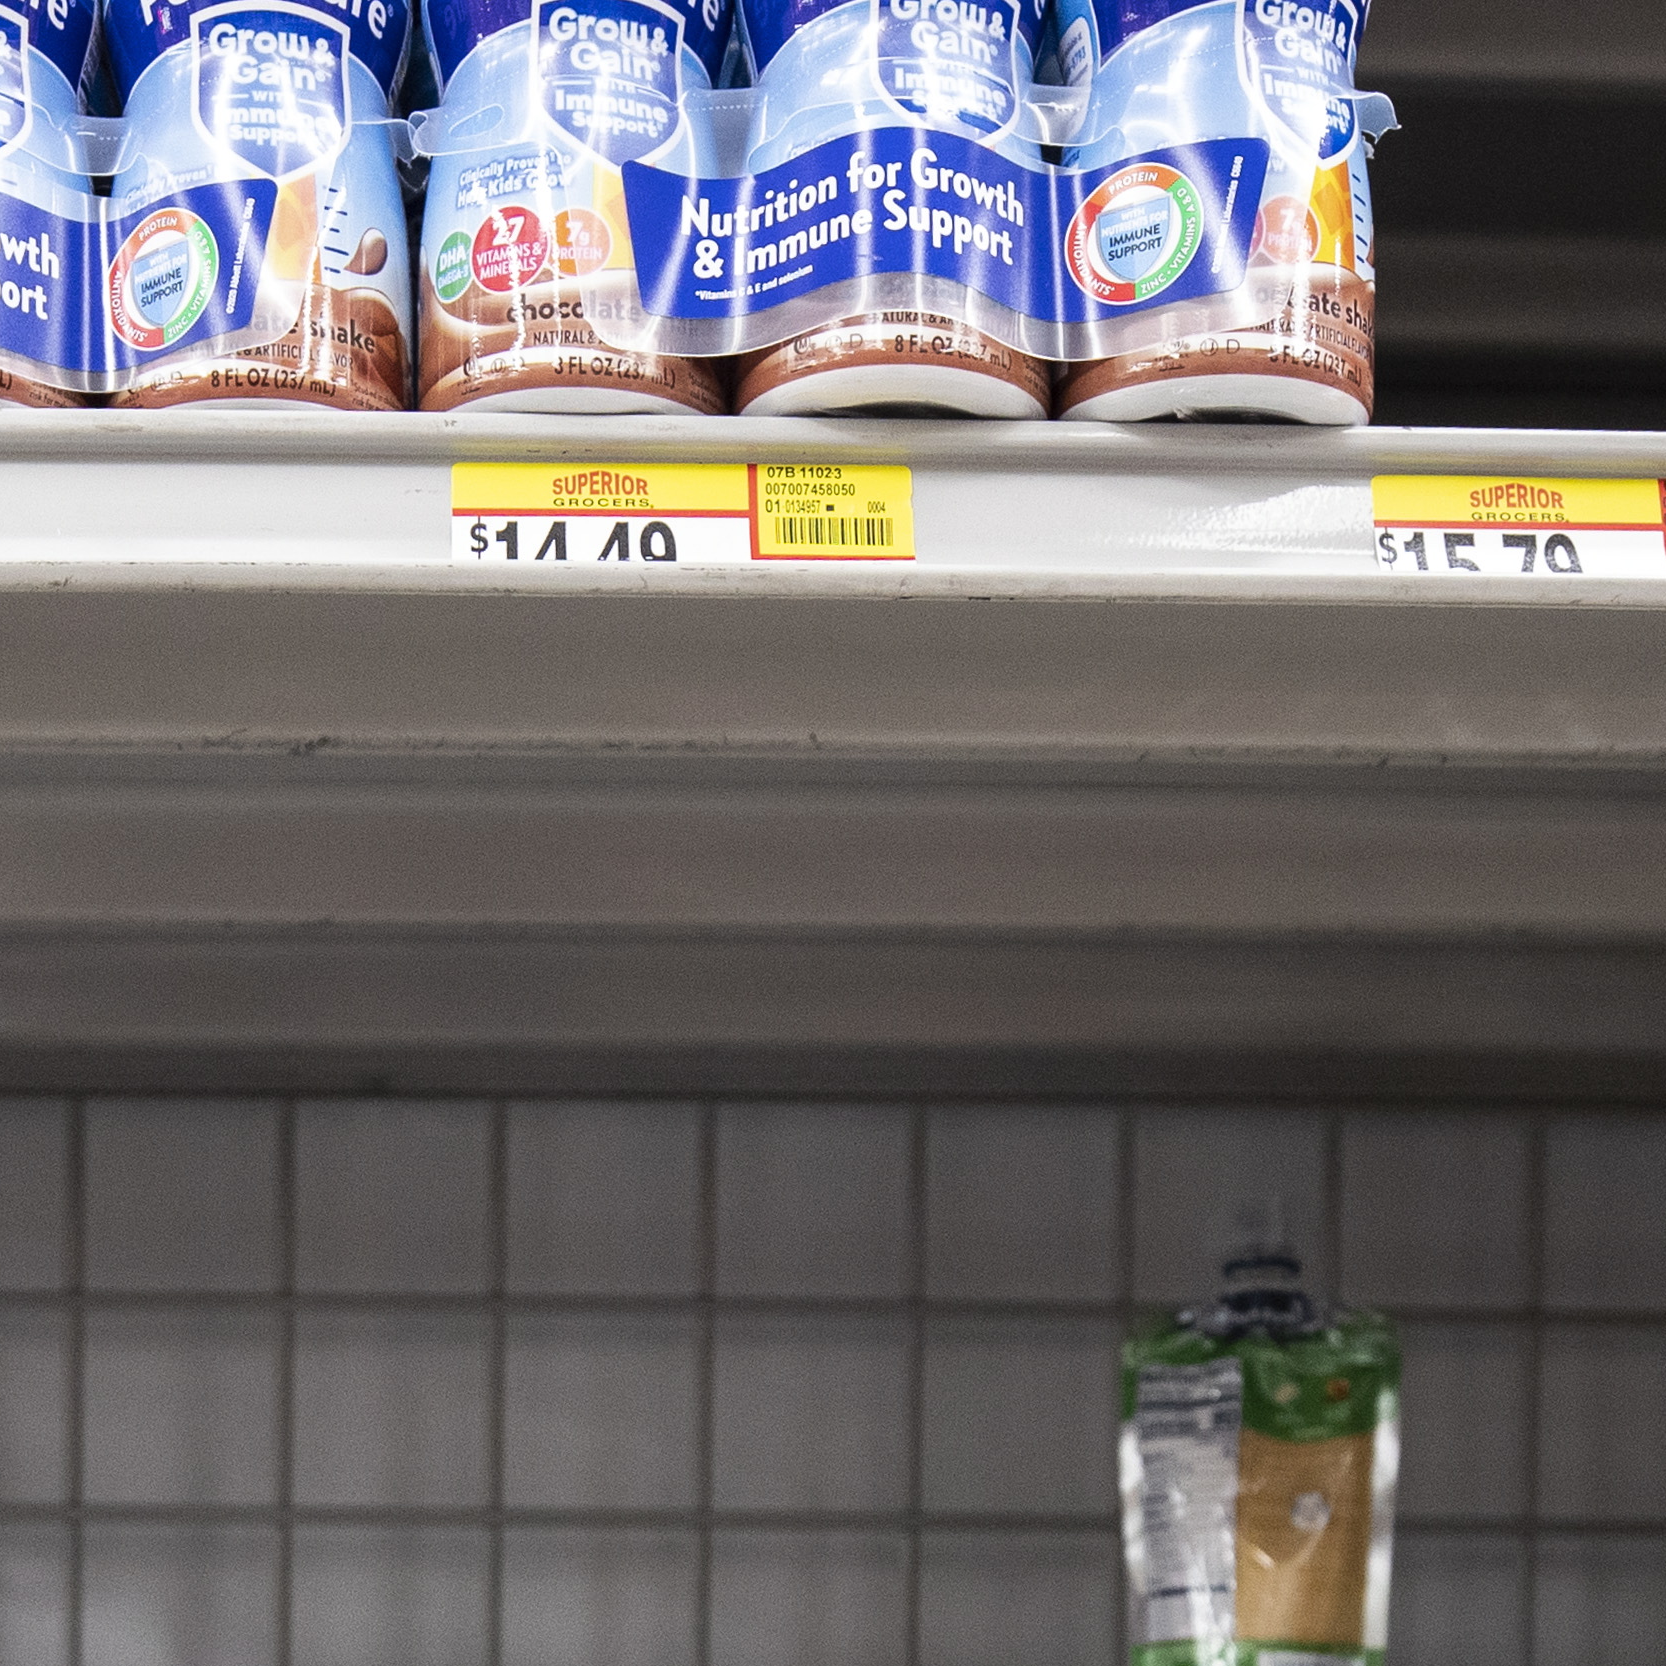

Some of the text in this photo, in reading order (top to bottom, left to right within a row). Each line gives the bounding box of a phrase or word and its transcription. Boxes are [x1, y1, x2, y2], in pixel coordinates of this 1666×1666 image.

[680, 148, 1025, 238] Nutrition for Growth
[691, 190, 1015, 279] & Immune Support
[1108, 222, 1162, 248] IMMUNE
[1107, 236, 1163, 262] SUPPORT
[552, 470, 650, 498] SUPERIOR
[765, 482, 857, 496] 007007458050
